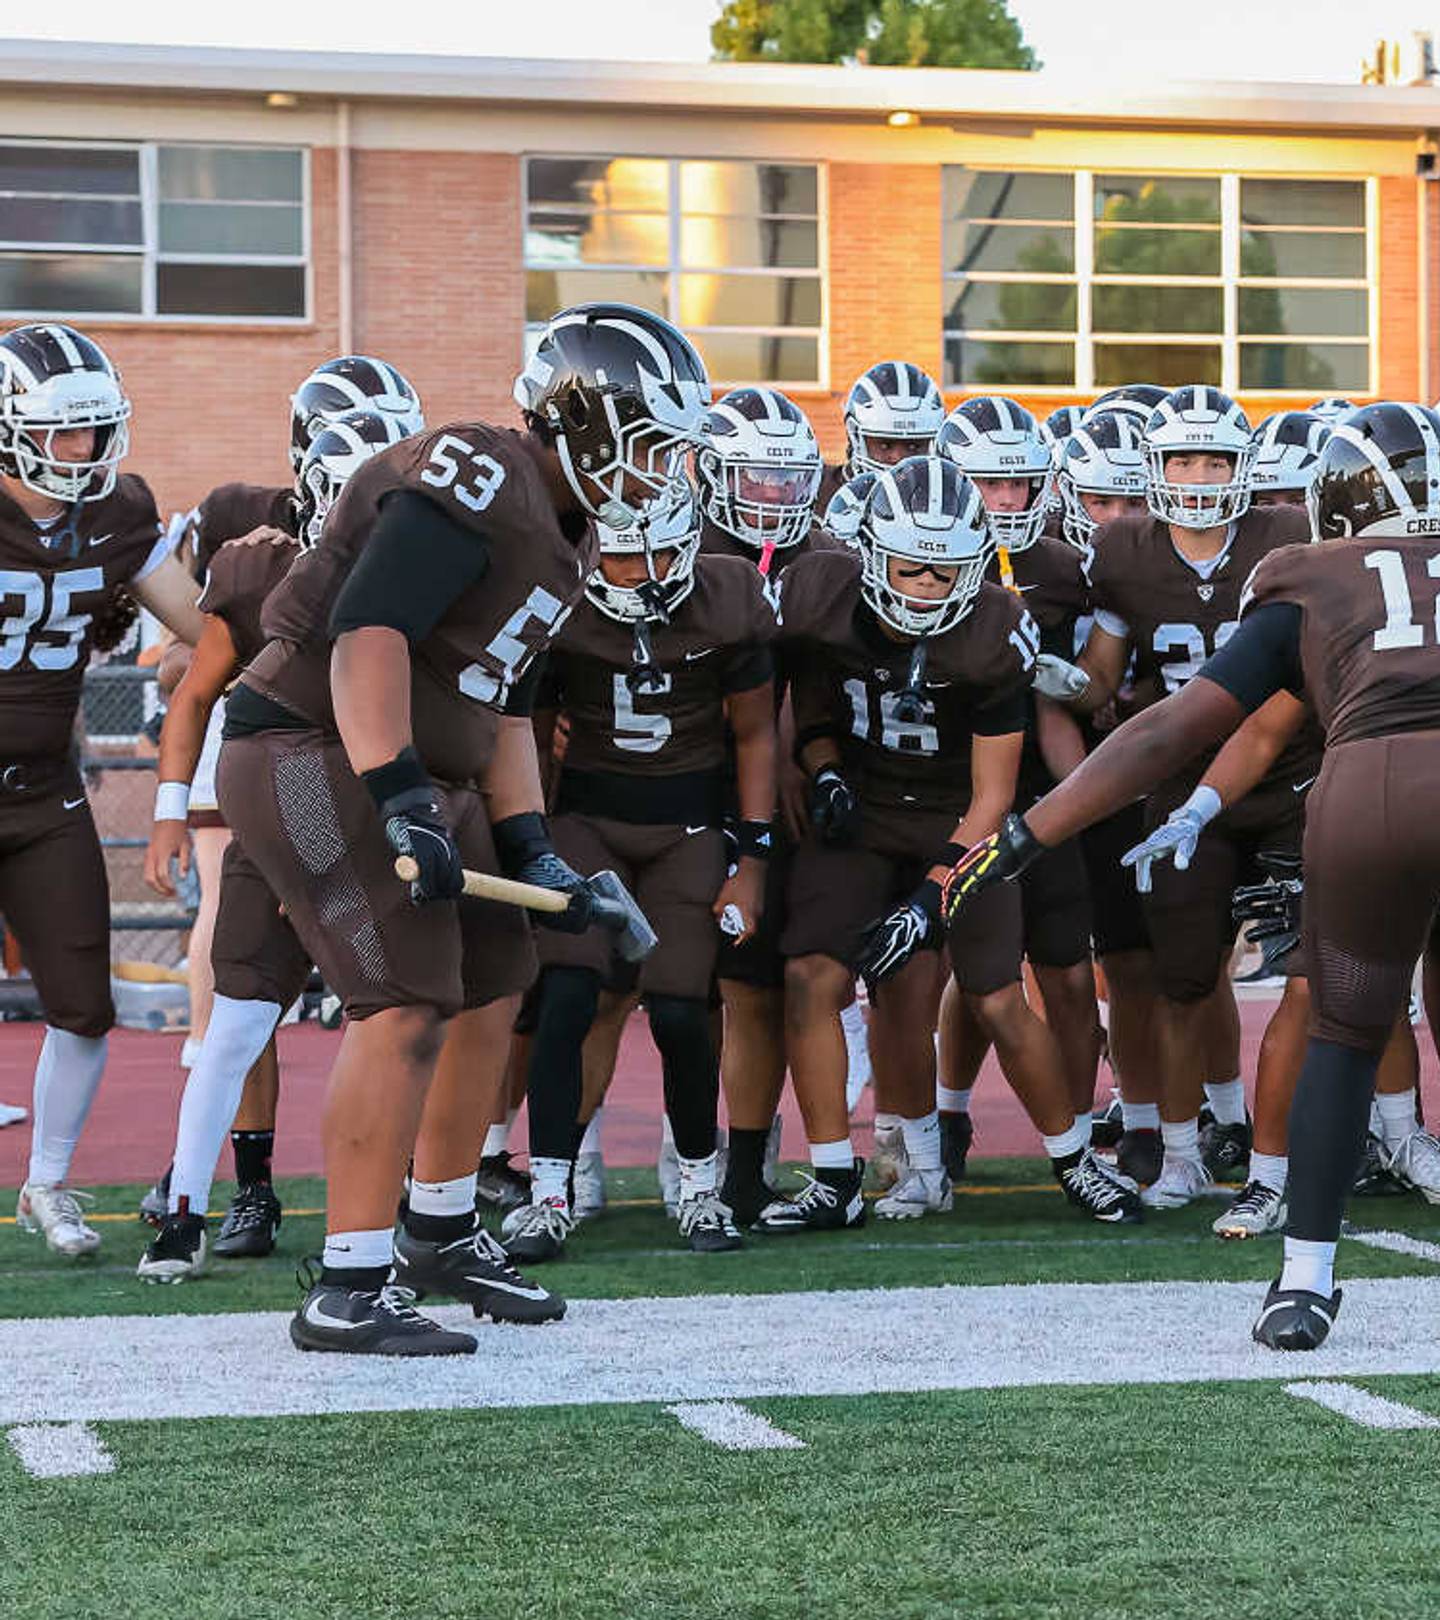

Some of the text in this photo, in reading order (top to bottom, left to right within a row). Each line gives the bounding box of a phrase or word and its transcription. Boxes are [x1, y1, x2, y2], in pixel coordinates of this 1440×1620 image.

[421, 435, 506, 511] 53
[767, 447, 793, 456] CELTS
[0, 566, 104, 670] 35
[459, 585, 572, 708] 5
[1153, 621, 1240, 693] 2
[613, 672, 672, 753] 5
[843, 679, 939, 756] 16
